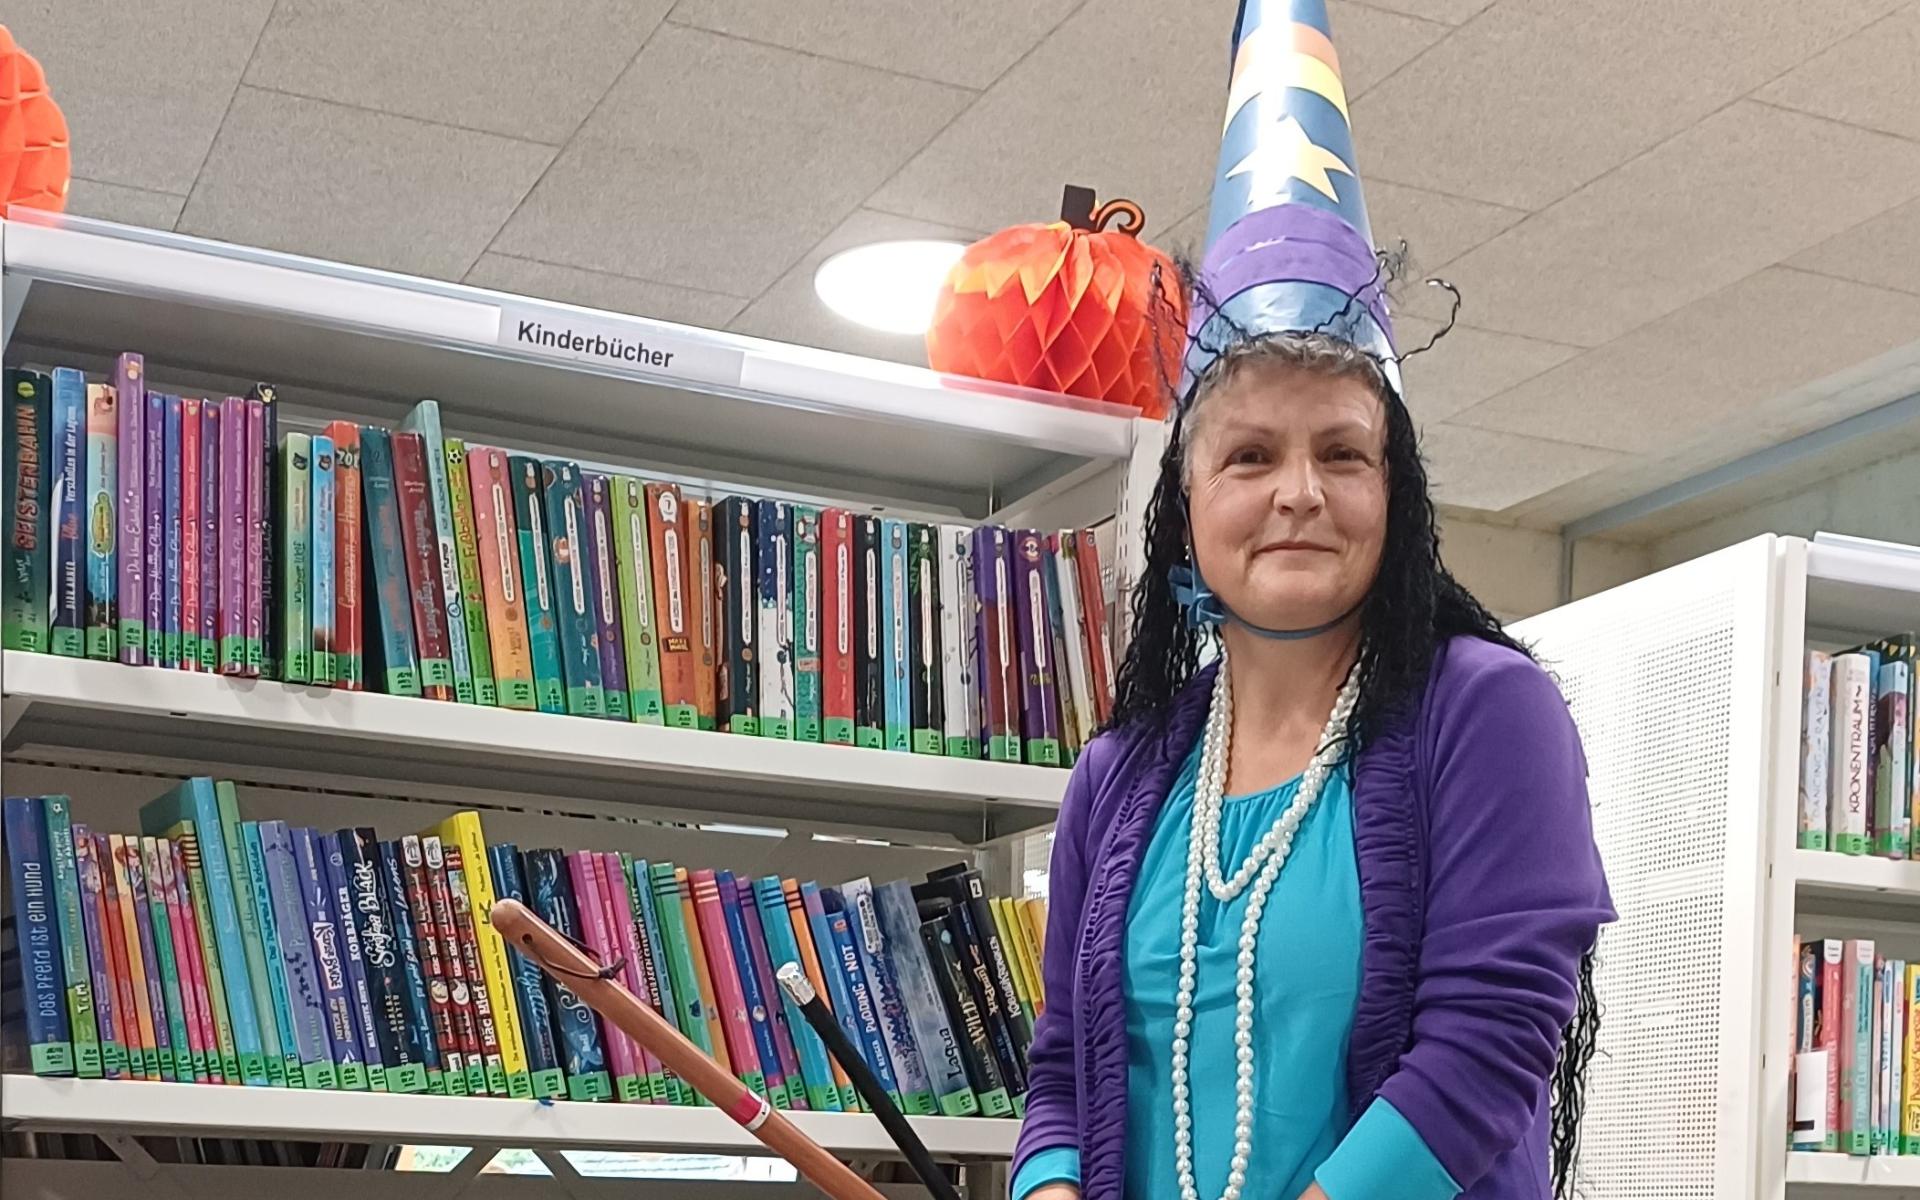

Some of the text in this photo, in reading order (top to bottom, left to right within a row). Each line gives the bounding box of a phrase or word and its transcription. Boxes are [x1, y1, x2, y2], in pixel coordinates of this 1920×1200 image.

[518, 321, 674, 367] Kinderbücher
[64, 434, 76, 448] der
[64, 448, 76, 457] in
[15, 405, 39, 550] GEISTERBAHN
[64, 457, 77, 502] Verschollen
[1849, 700, 1863, 814] KRONENTRAUM
[386, 857, 409, 910] Lebens
[972, 881, 981, 897] 2
[27, 901, 47, 922] ein
[339, 886, 361, 961] KORBJÄGER
[30, 926, 49, 946] ist
[841, 944, 860, 972] NOT
[33, 951, 54, 989] Pferd
[474, 984, 497, 1046] Mäc Mief
[852, 982, 877, 1034] PUDDING
[938, 1027, 963, 1080] Laqua
